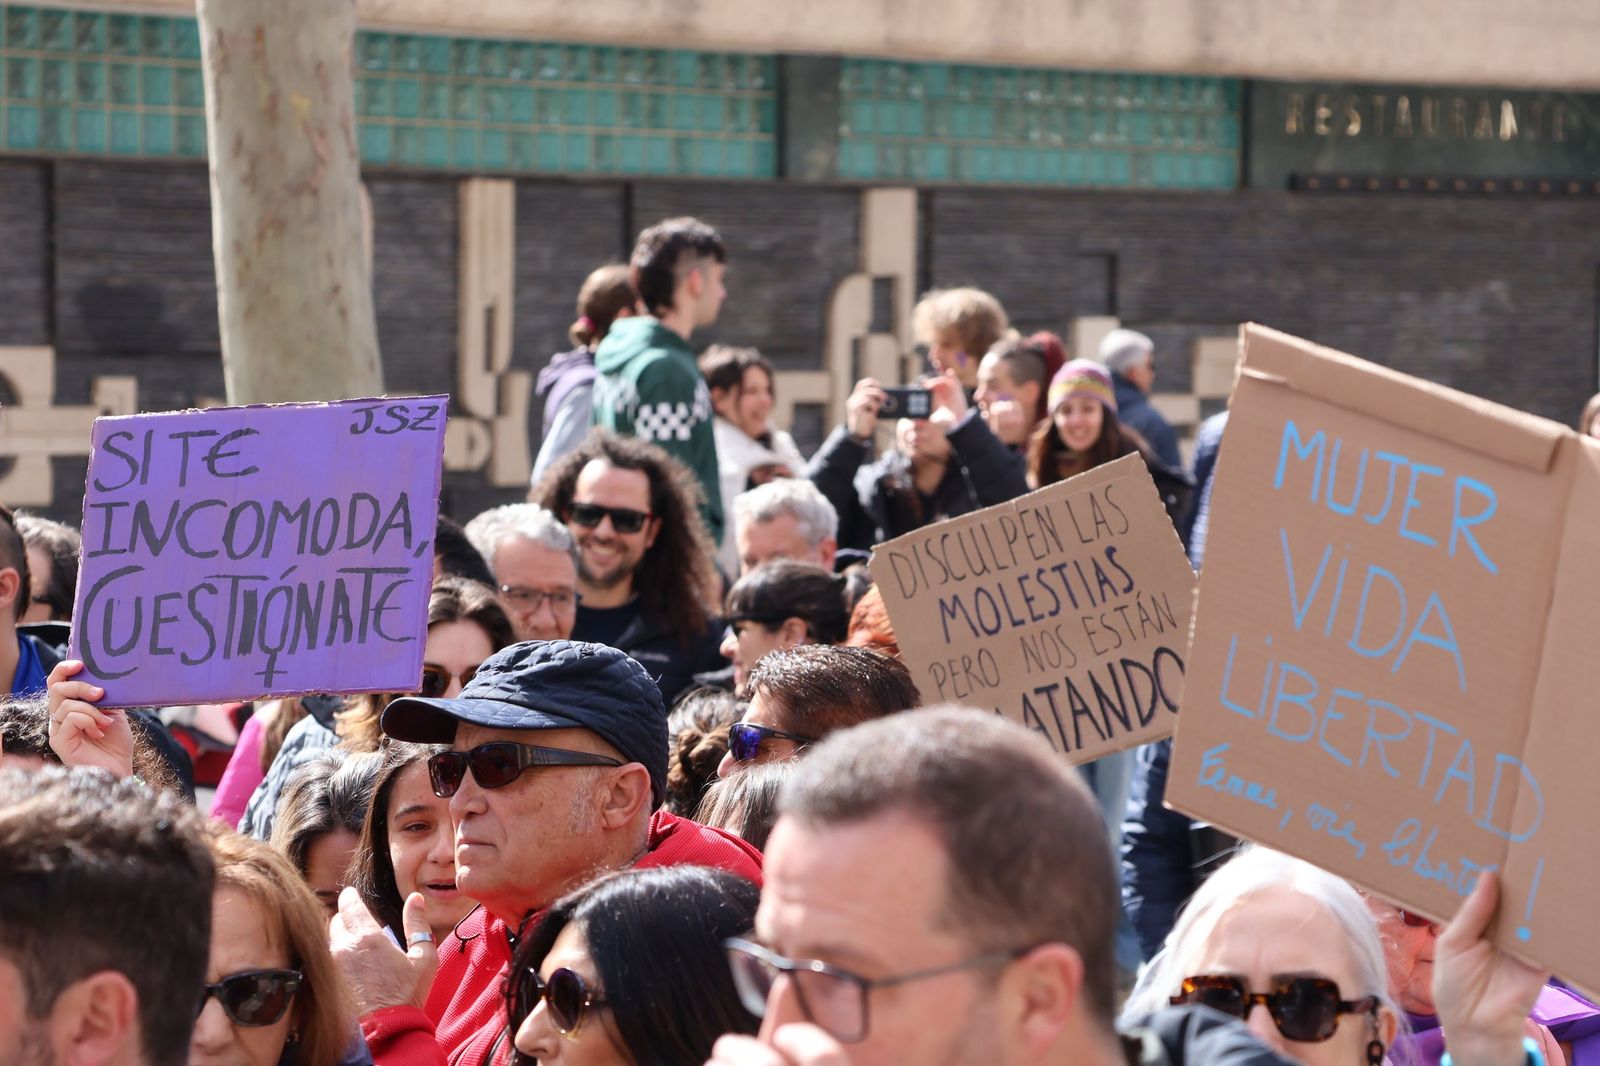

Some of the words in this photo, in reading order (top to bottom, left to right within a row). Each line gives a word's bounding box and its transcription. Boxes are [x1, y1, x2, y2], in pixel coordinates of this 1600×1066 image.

[93, 429, 154, 492] SI
[169, 428, 260, 488] TE
[350, 404, 440, 435] JSZ
[88, 491, 431, 560] INCOMODA,
[889, 506, 1064, 600] DISCULPEN
[1065, 484, 1129, 544] LAS
[1273, 419, 1499, 575] MUJER
[79, 565, 417, 688] CUESTIÓNATE
[928, 648, 1000, 701] PERO
[1020, 623, 1078, 674] NOS
[1081, 591, 1178, 656] ESTÁN
[938, 546, 1134, 644] MOLESTIAS
[995, 646, 1186, 753] ATANDO
